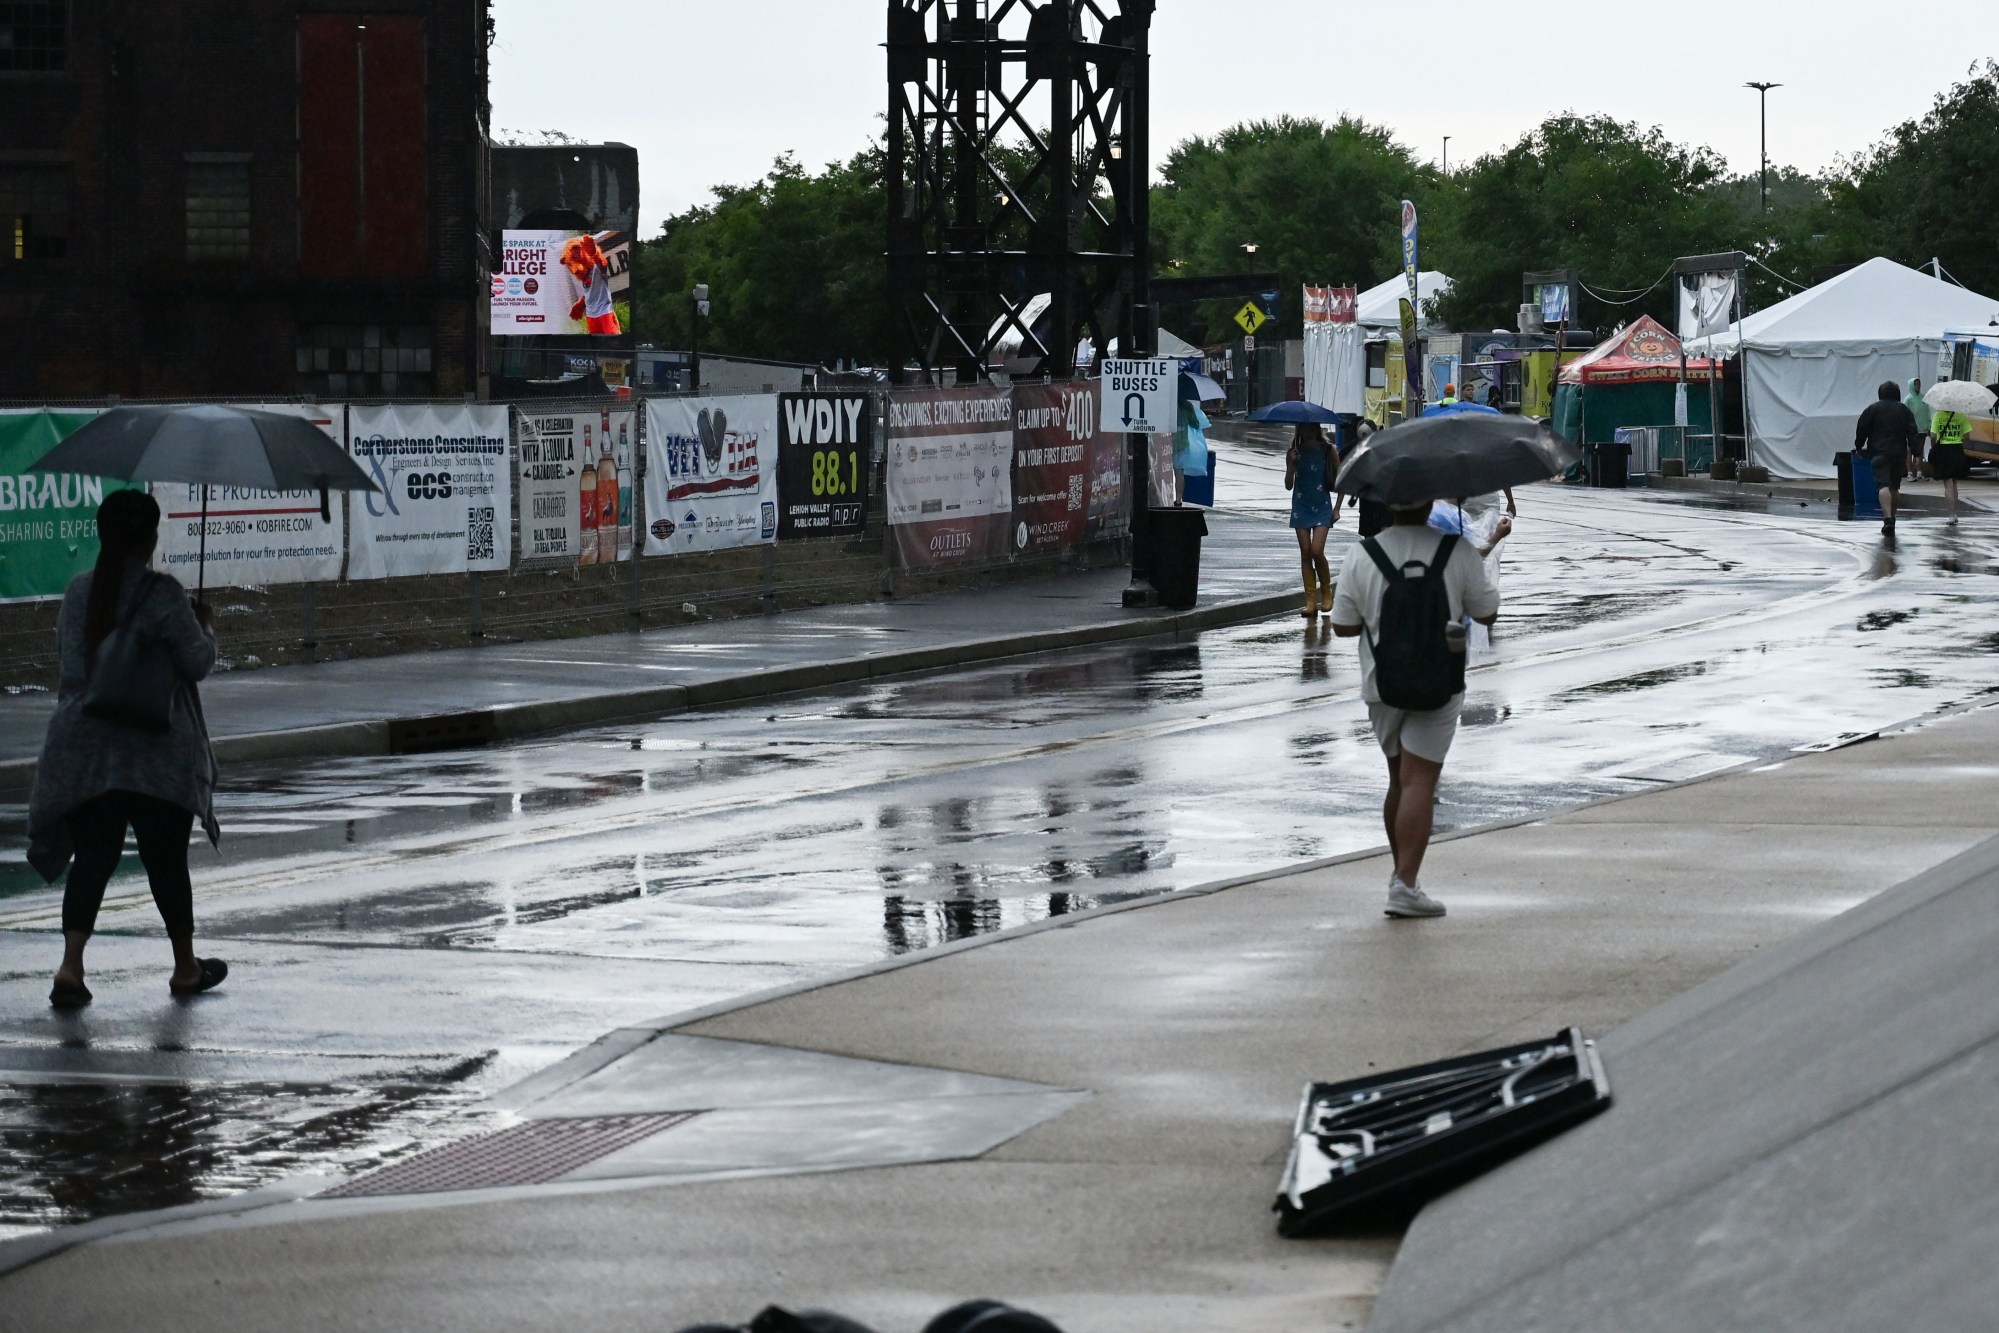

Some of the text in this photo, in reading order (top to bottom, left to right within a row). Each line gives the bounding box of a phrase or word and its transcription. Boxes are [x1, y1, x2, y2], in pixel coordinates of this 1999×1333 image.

[509, 240, 534, 248] SPARK
[536, 240, 546, 248] AT
[503, 249, 547, 261] RIGHT
[492, 261, 547, 275] LLEGE
[1634, 330, 1665, 342] CORN
[1104, 361, 1167, 376] SHUTTLE
[1633, 368, 1668, 379] CORN
[1112, 377, 1158, 391] BUSES
[890, 397, 1012, 428] BIG SAVINGS, EXCITING EXPERIENCES
[1018, 406, 1060, 430] CLAIM UP TO
[784, 398, 863, 445] WDIY
[354, 435, 504, 457] Cornerstone Consulting
[522, 437, 574, 462] WITH TEQUILA
[392, 456, 421, 470] Engineers
[423, 456, 430, 467] &
[432, 455, 452, 469] Design
[1018, 444, 1084, 467] ON YOUR FIRST DEPOSIT!
[452, 471, 494, 483] construction
[811, 450, 857, 496] 88.1
[452, 485, 494, 497] management
[1018, 495, 1028, 504] Scan
[1036, 492, 1057, 501] welcome
[1057, 490, 1067, 500] offer
[533, 496, 566, 519] CAZADORES
[789, 503, 830, 515] LEHIGH VALLEY
[794, 517, 830, 528] PUBLIC RADIO
[834, 508, 858, 525] npr
[0, 519, 98, 541] SHARING EXPER
[187, 518, 313, 537] 800-322-9060 KOBFIRE.COM
[534, 528, 545, 541] REAL
[545, 527, 567, 541] TEQUILA
[1029, 520, 1070, 535] WIND CREEK
[431, 531, 436, 541] of
[436, 530, 465, 540] development
[930, 532, 971, 550] OUTLETS
[162, 553, 167, 564] A
[168, 551, 201, 565] complete
[202, 549, 231, 562] solution
[233, 547, 244, 560] for
[245, 549, 263, 562] your
[264, 546, 276, 558] fire
[278, 544, 314, 559] protection
